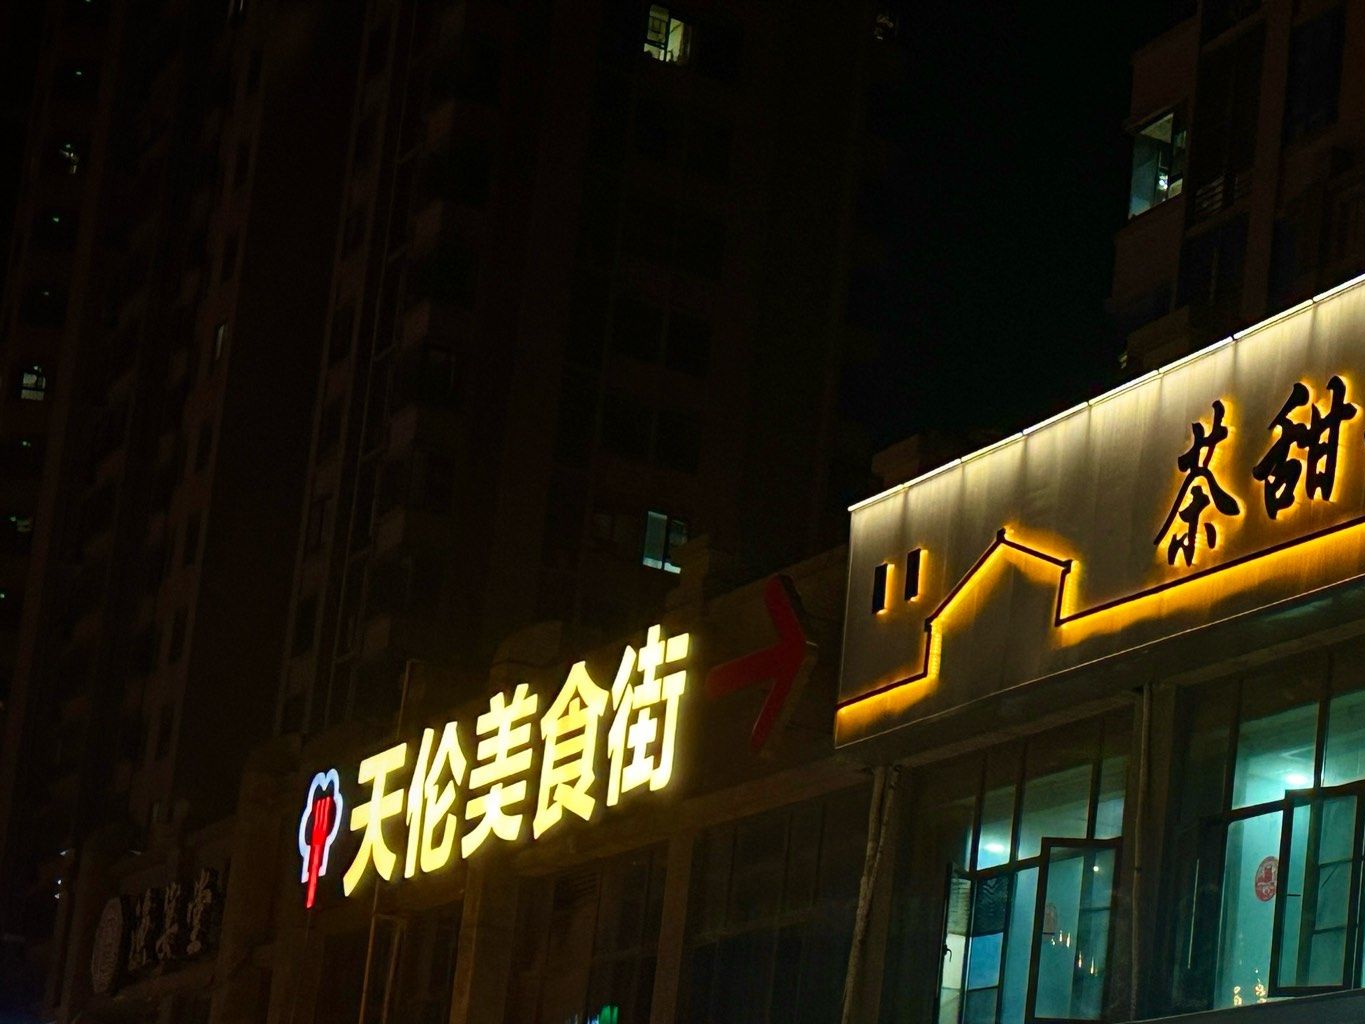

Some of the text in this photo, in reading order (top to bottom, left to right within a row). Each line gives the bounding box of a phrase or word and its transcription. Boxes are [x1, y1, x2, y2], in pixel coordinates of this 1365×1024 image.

[343, 625, 693, 897] 天伦美食街
